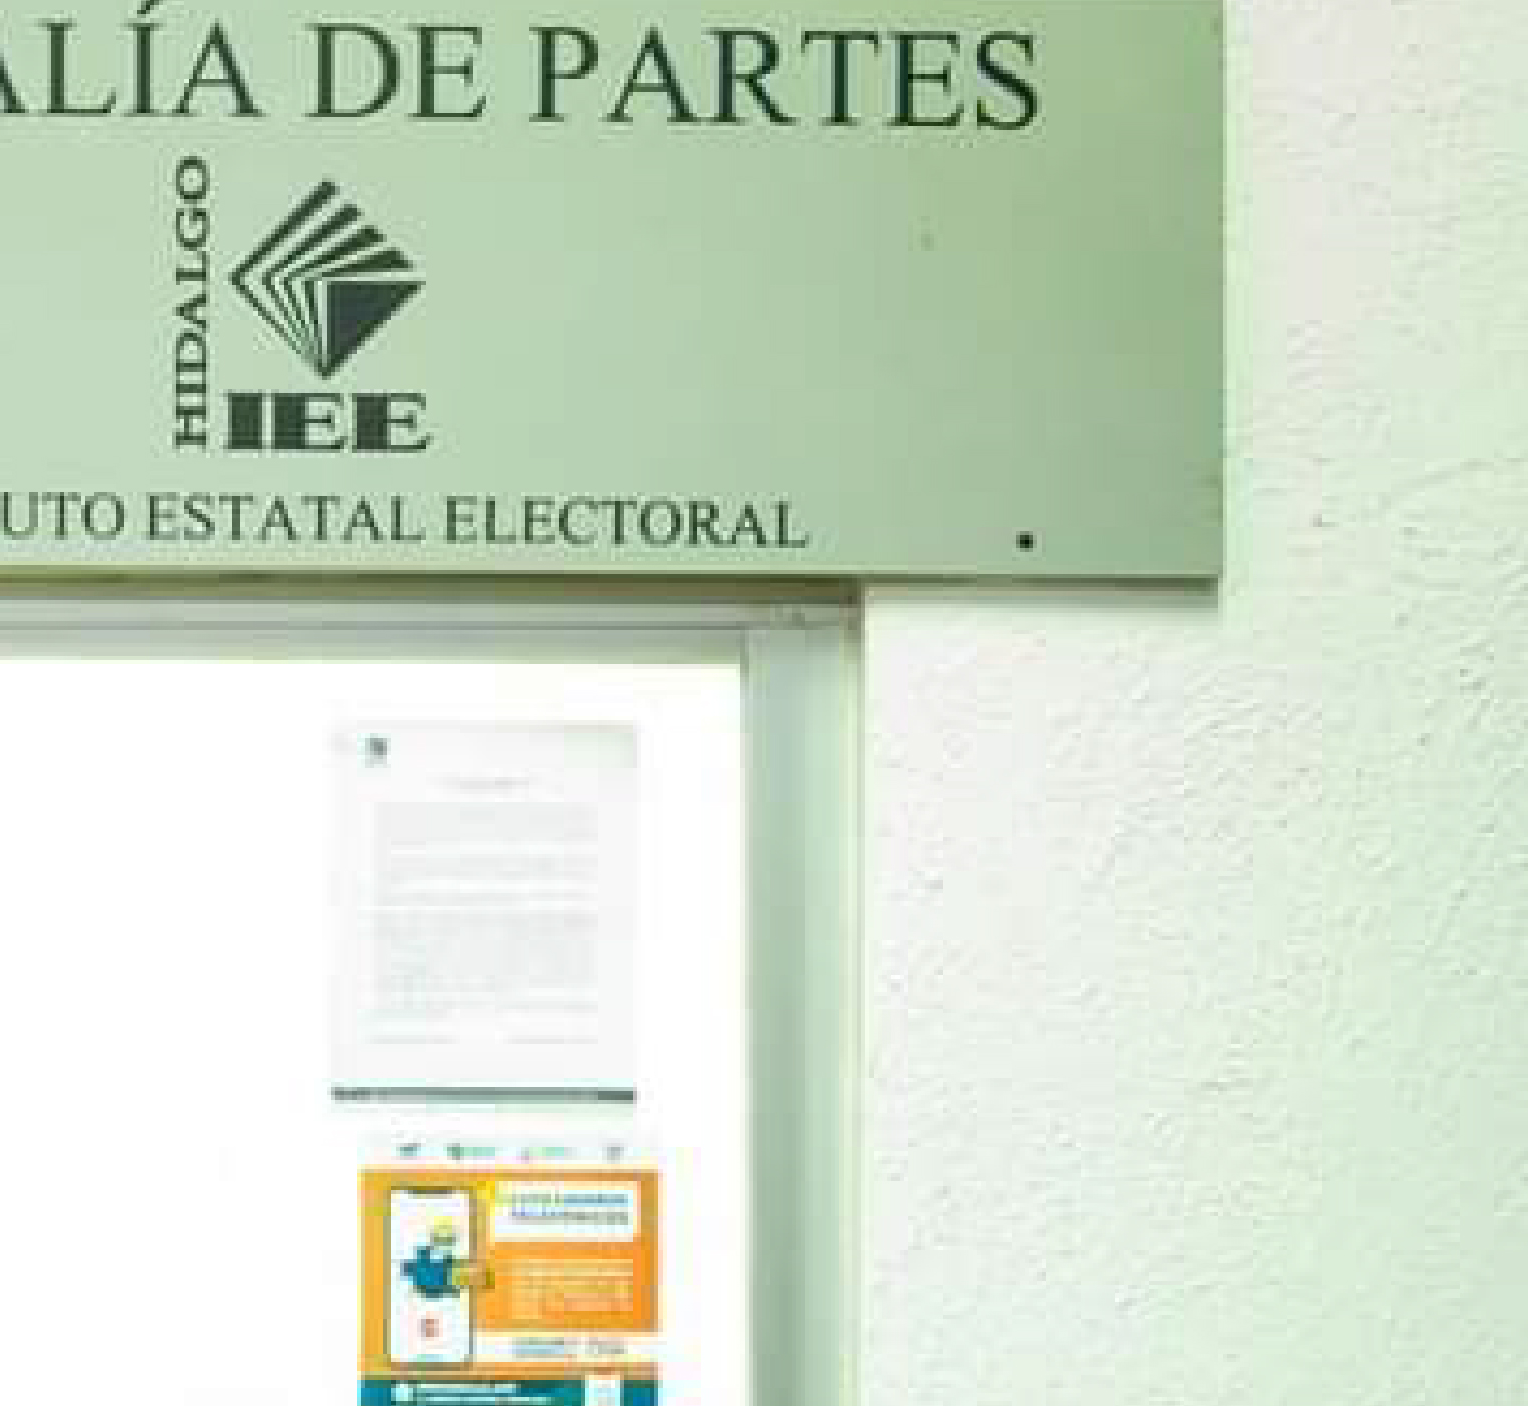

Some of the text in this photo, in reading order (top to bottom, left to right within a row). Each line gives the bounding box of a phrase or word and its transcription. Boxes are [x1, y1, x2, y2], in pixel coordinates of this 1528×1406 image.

[307, 21, 486, 119] DE
[528, 26, 1040, 131] PARTES
[174, 155, 209, 448] HIDALGO
[225, 391, 431, 454] IEE
[146, 492, 423, 543] ESTATAL
[444, 494, 809, 550] ELECTORAL
